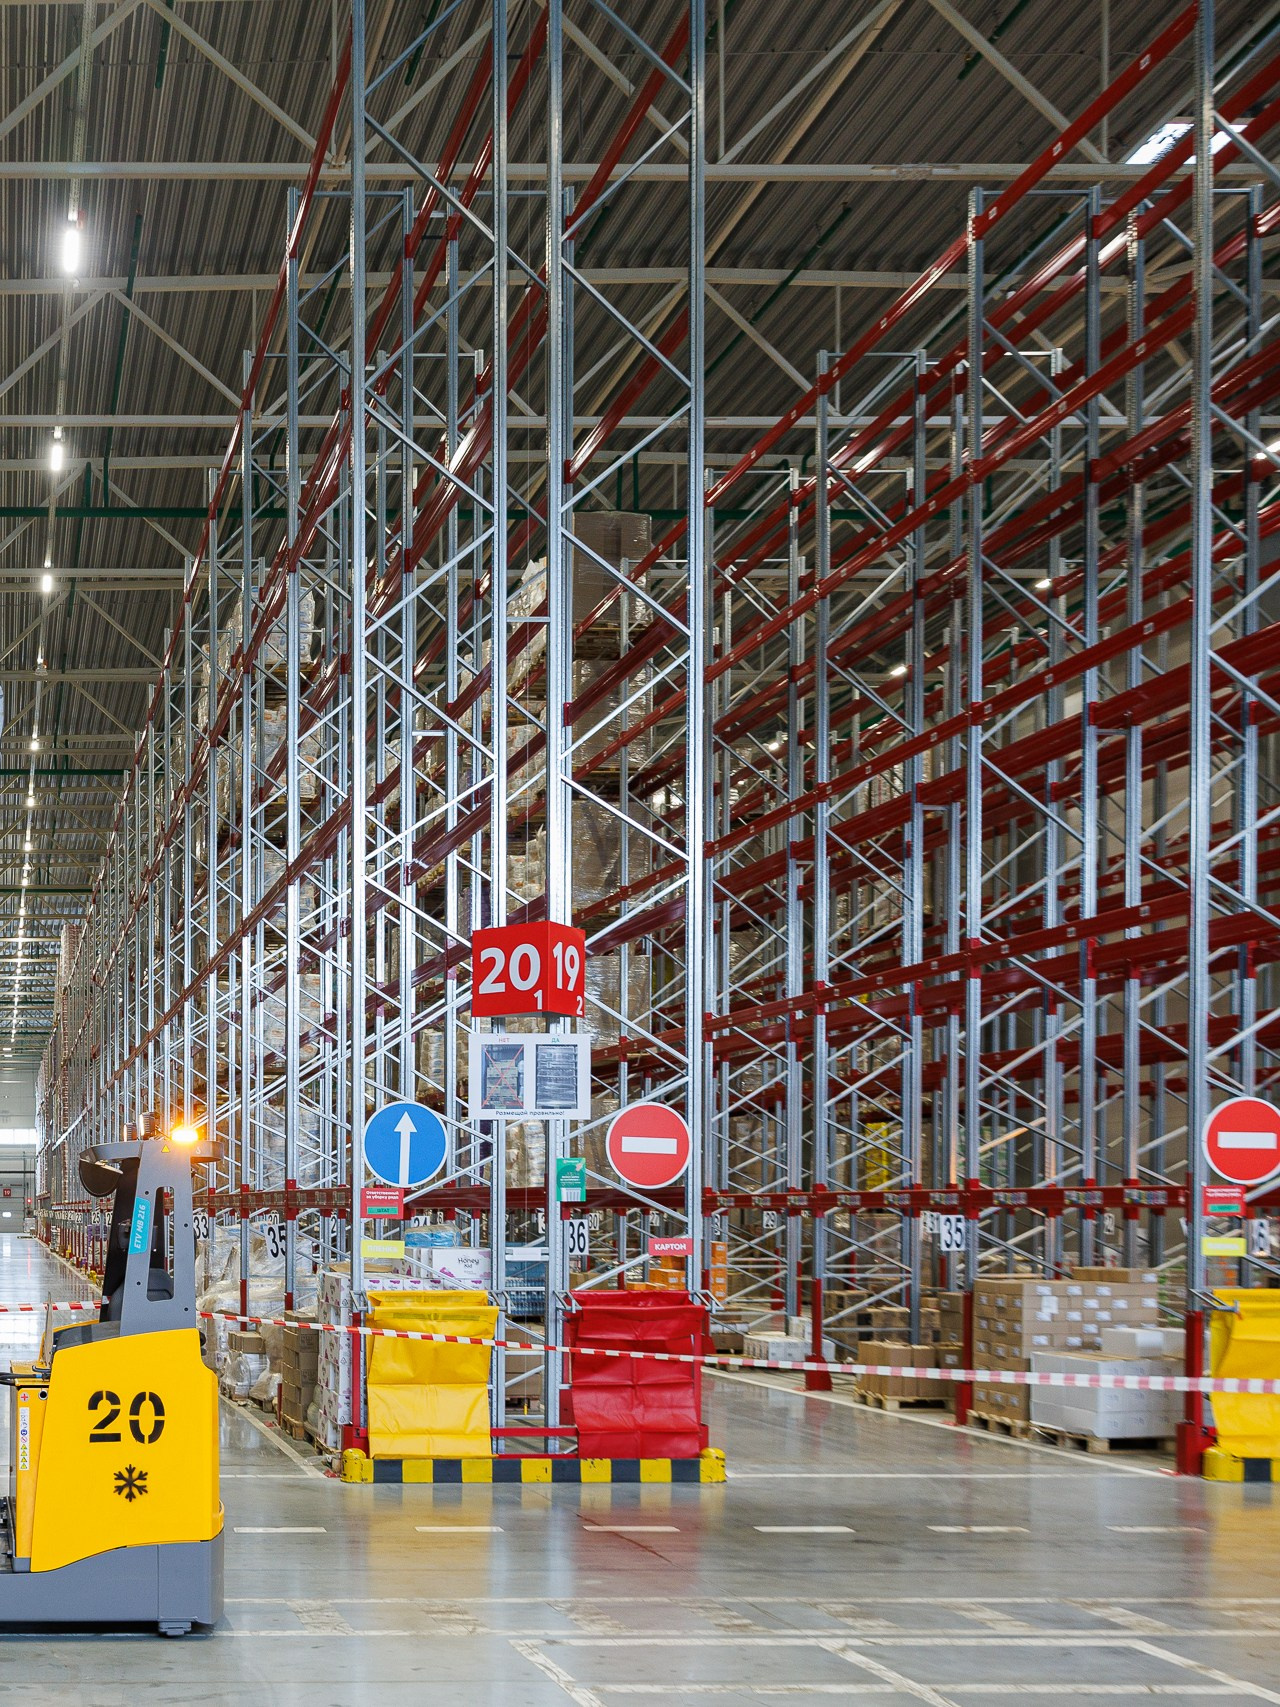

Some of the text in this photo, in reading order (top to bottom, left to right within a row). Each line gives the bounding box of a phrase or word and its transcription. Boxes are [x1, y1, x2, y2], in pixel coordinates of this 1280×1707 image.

[478, 943, 541, 995] 20
[552, 941, 580, 992] 19
[533, 989, 543, 1010] 1
[576, 995, 584, 1016] 2
[134, 1233, 143, 1249] ETV
[944, 1217, 963, 1248] 35
[458, 1257, 479, 1265] Honey
[88, 1389, 165, 1444] 20
